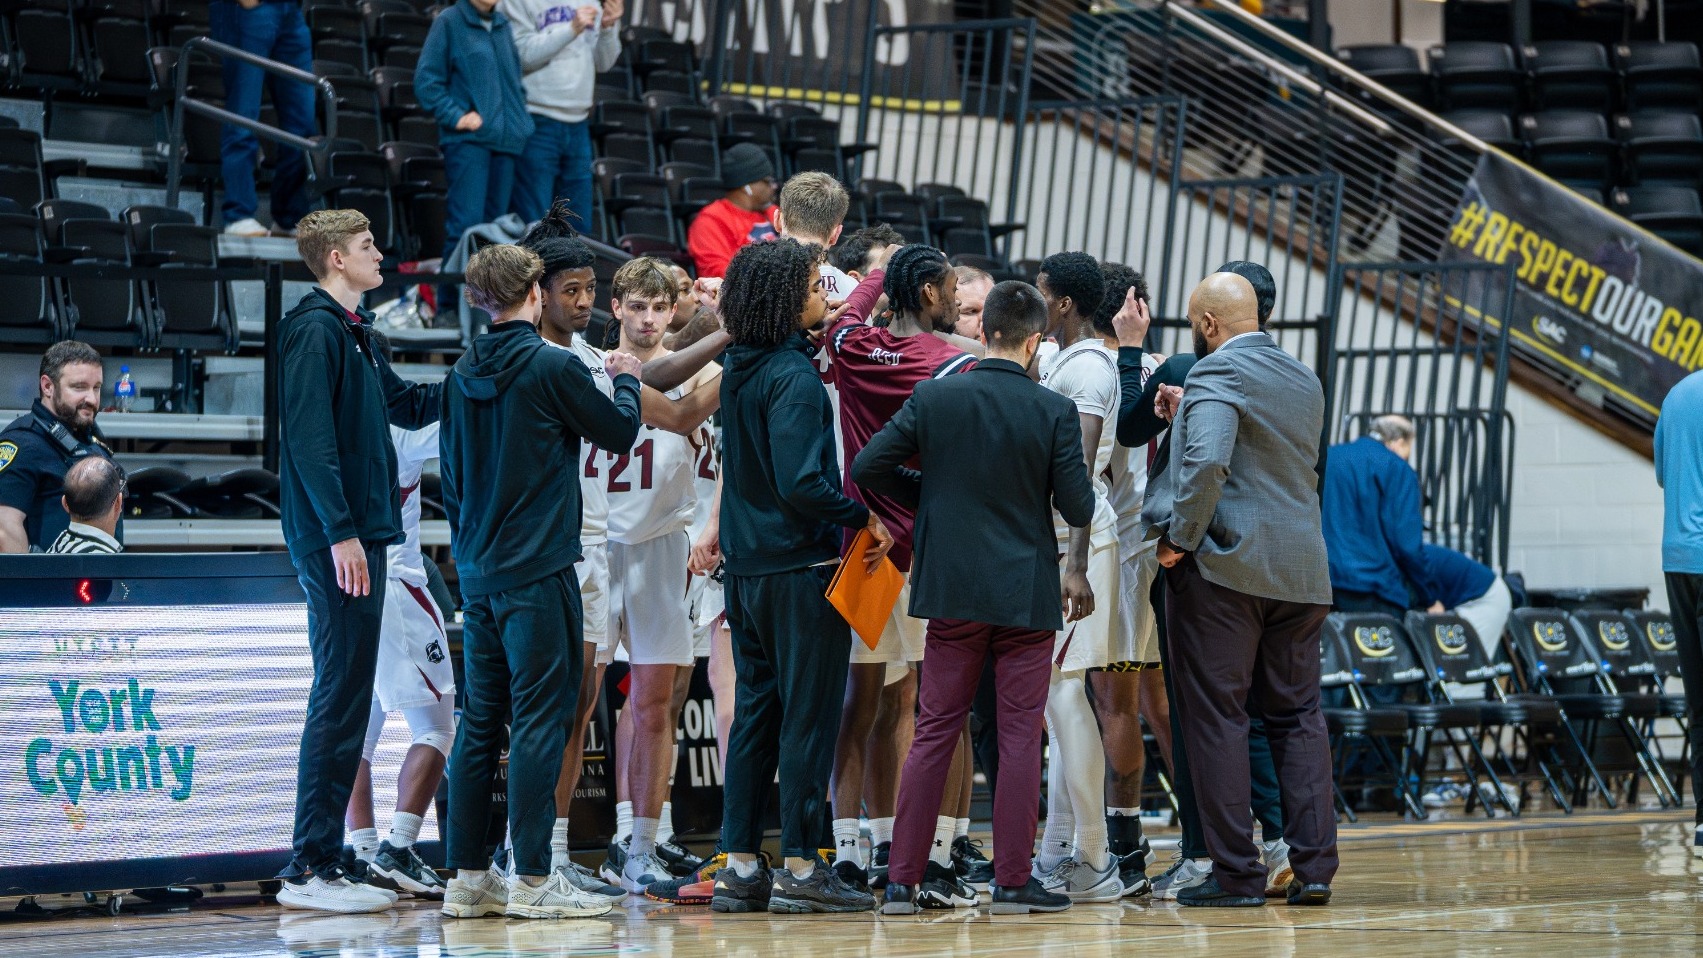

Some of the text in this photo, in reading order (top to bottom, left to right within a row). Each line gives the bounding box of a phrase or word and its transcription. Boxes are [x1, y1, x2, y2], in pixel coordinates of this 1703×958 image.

[1537, 316, 1568, 345] SAC
[606, 438, 655, 493] 21
[48, 677, 162, 733] York
[25, 735, 196, 806] County
[571, 787, 607, 799] OURISM
